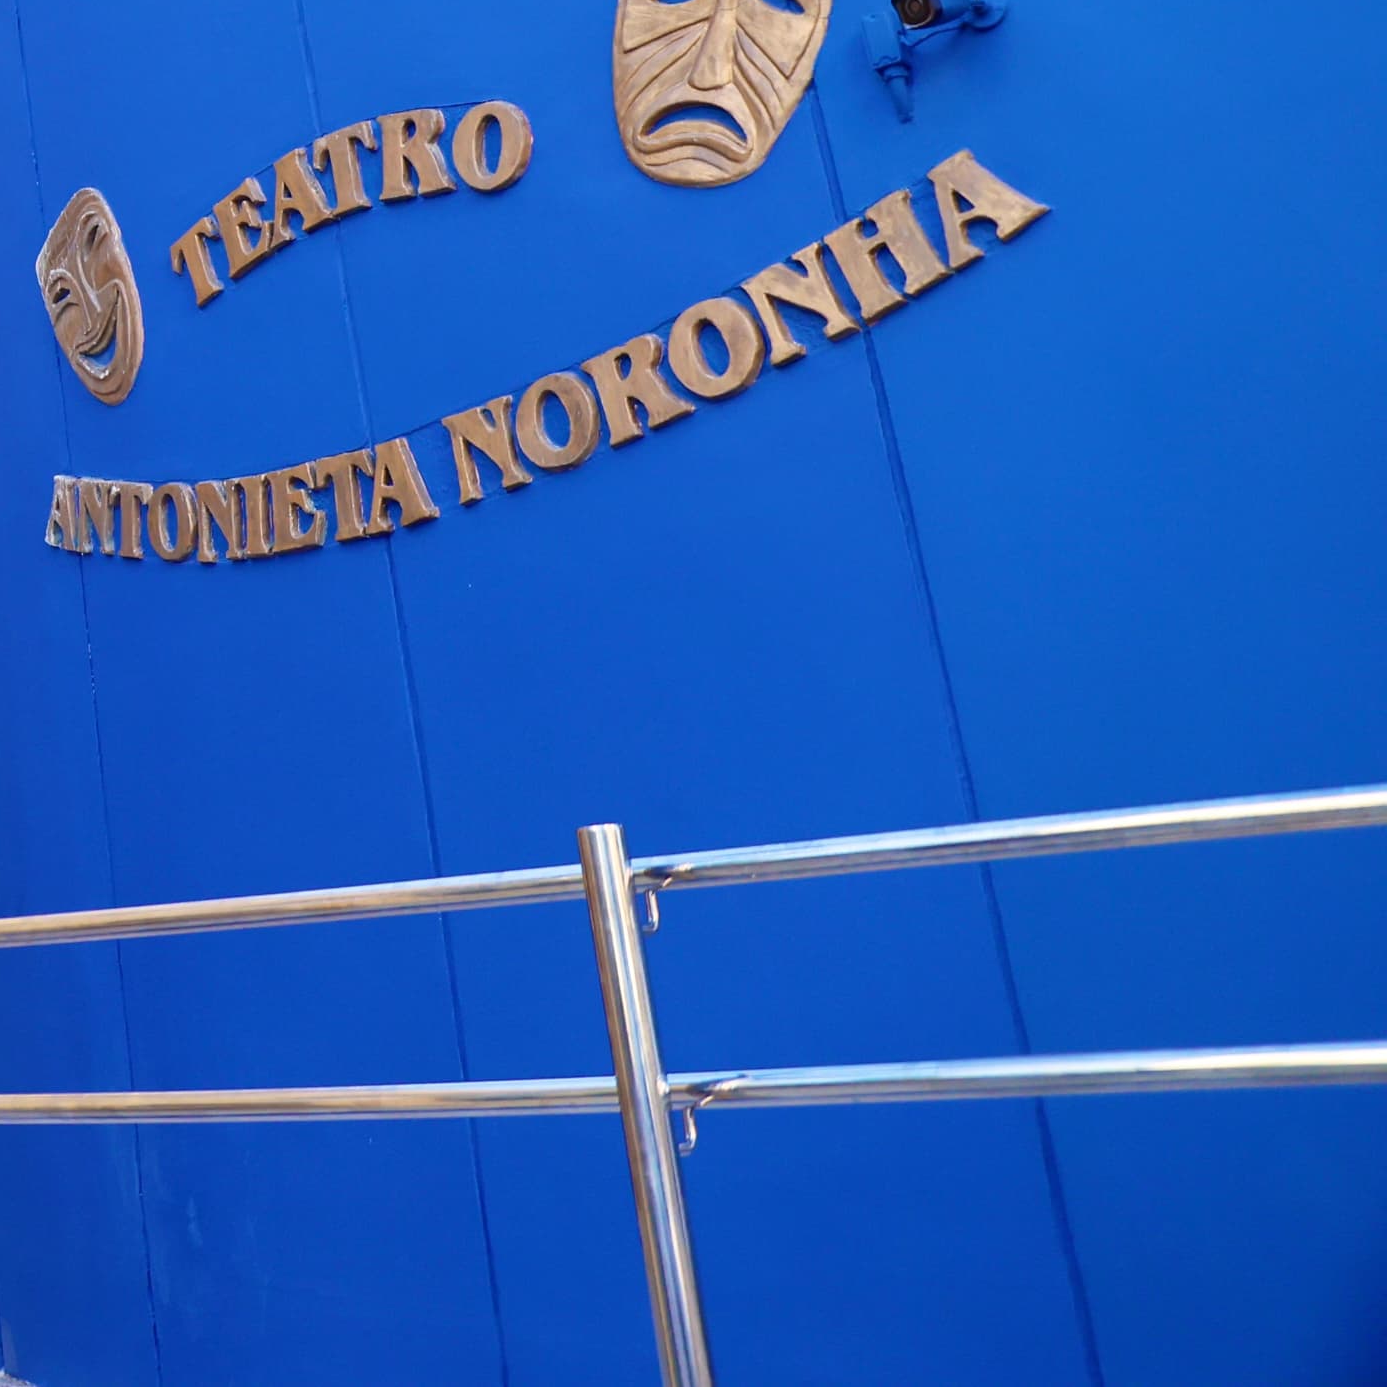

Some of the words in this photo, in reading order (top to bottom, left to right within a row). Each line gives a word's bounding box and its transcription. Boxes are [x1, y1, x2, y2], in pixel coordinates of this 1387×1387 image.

[44, 437, 440, 564] ANTONIETA
[441, 149, 1051, 506] NORONHA
[170, 100, 533, 307] TEATRO
